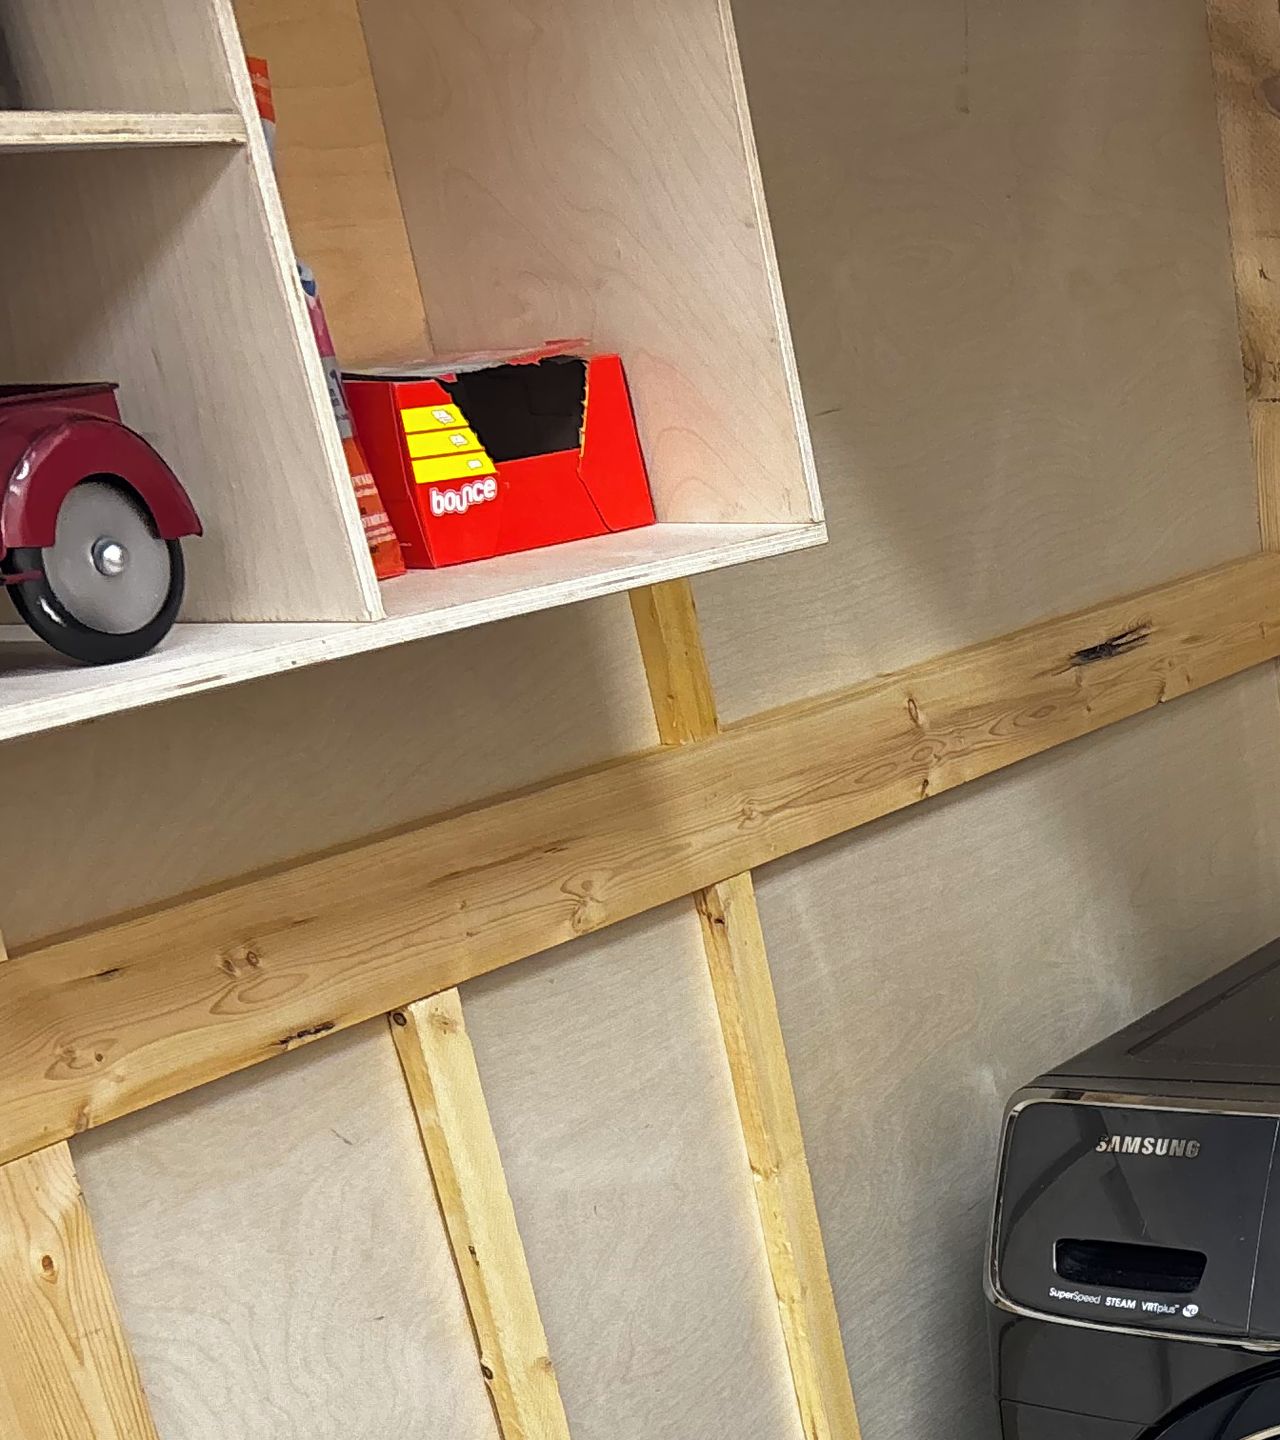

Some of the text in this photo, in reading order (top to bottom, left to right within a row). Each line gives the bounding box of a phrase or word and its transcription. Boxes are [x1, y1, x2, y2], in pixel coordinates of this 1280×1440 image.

[429, 478, 500, 516] bounce
[1095, 1134, 1201, 1159] SAMSUNG
[1049, 1287, 1101, 1304] SuperSpeed
[1105, 1297, 1136, 1309] STEAM
